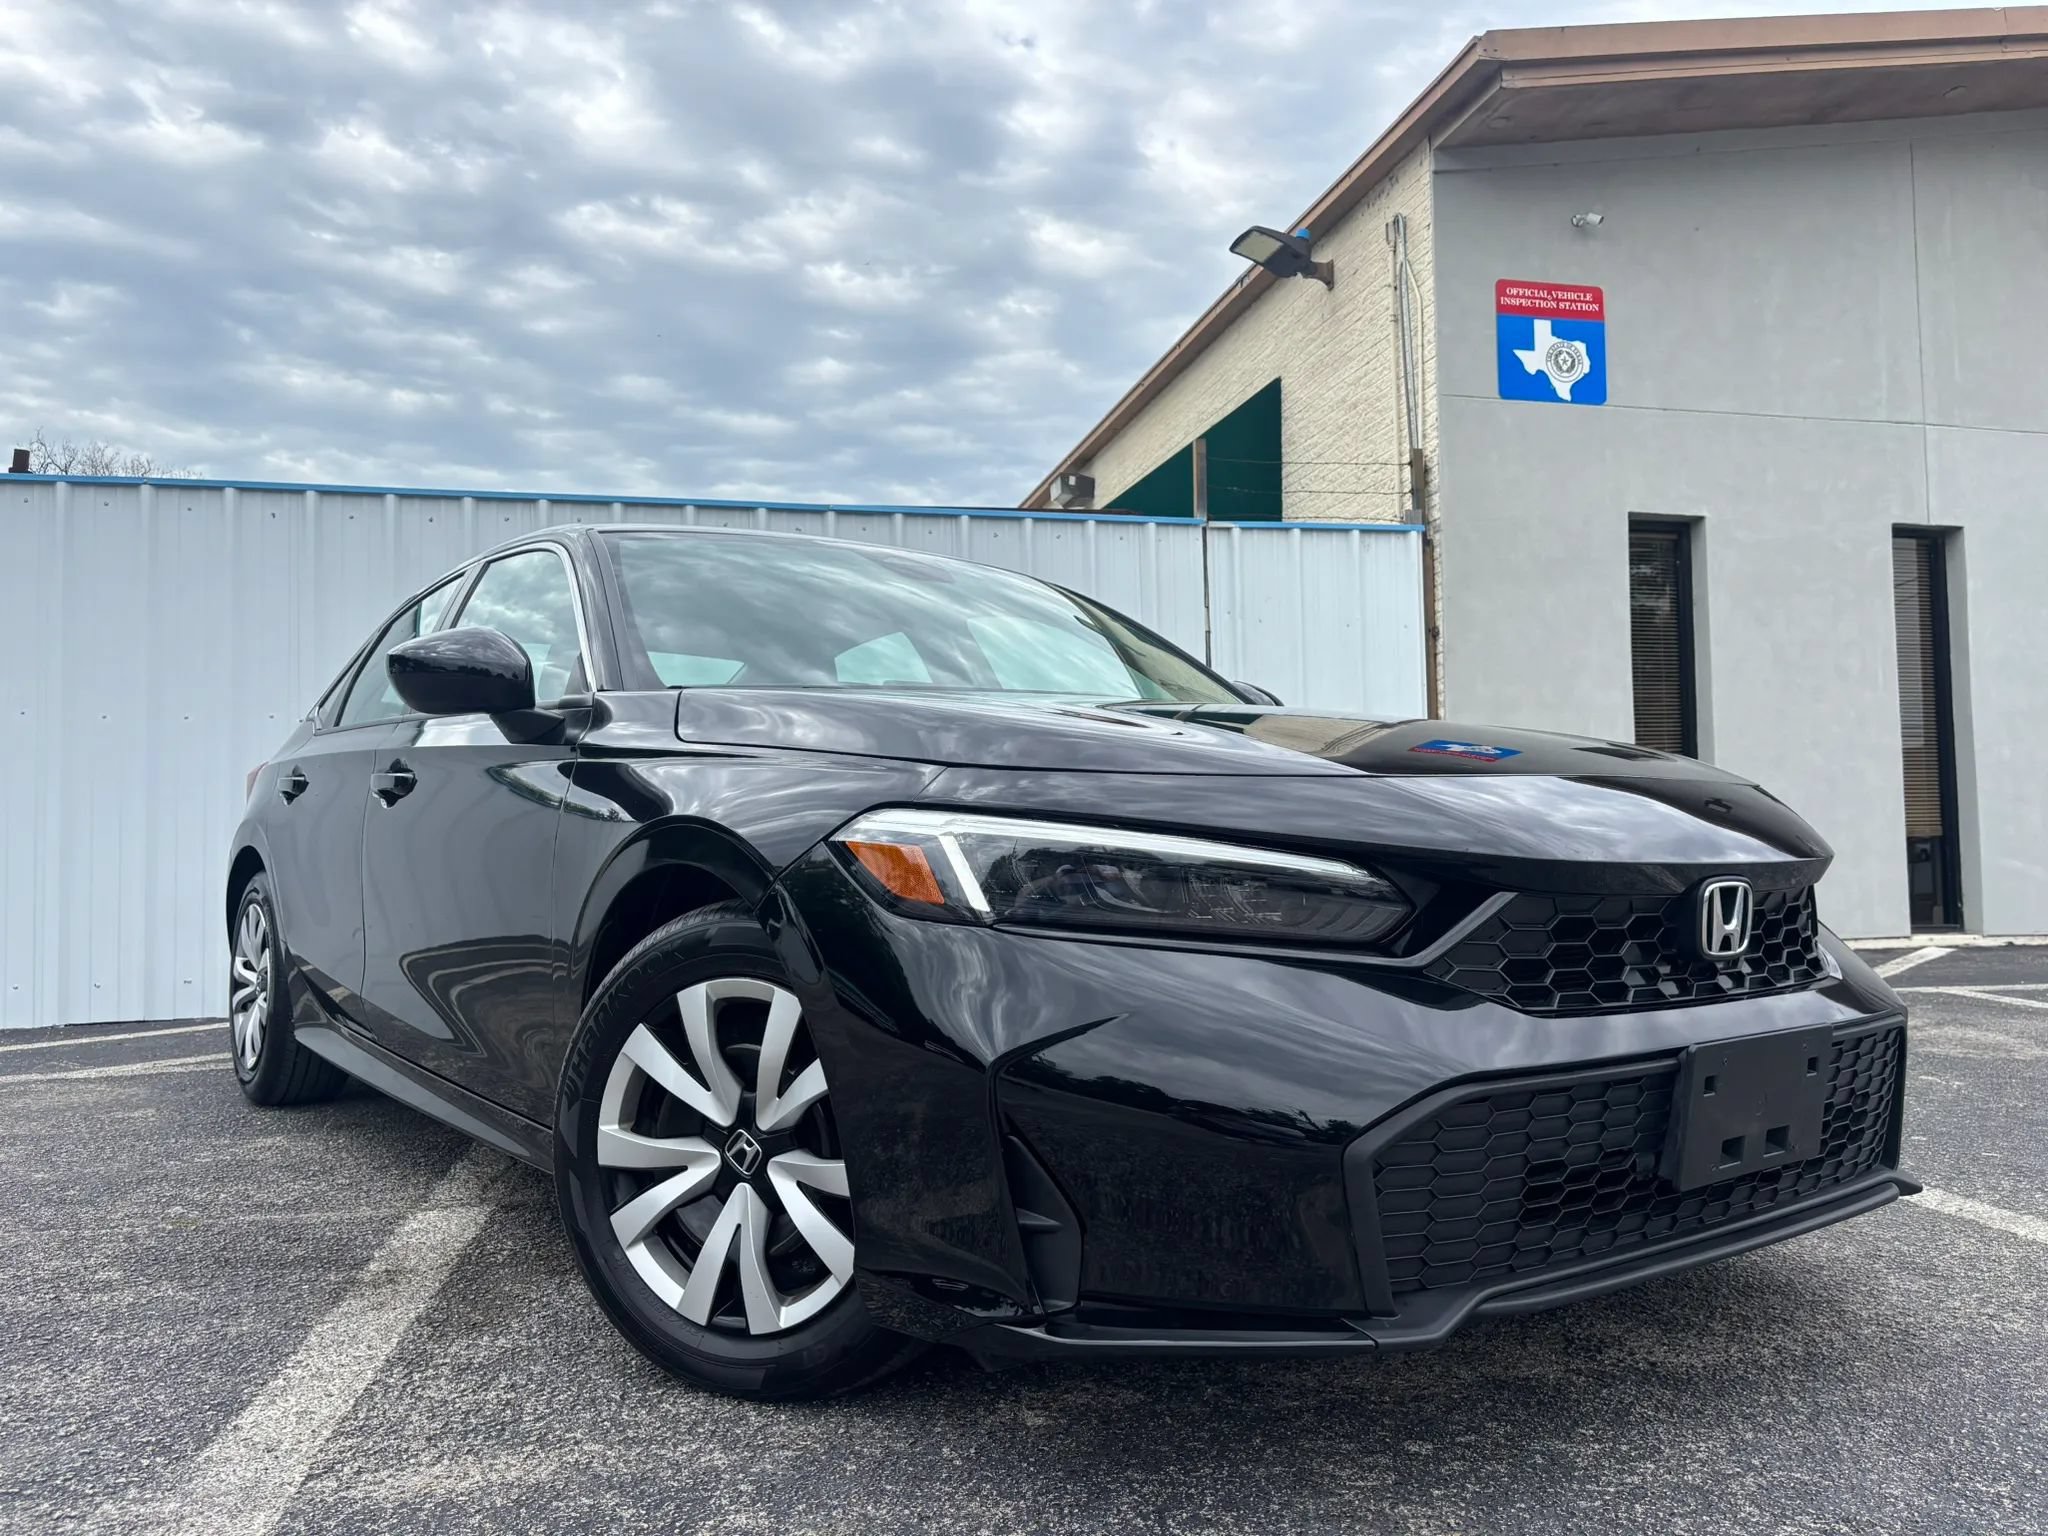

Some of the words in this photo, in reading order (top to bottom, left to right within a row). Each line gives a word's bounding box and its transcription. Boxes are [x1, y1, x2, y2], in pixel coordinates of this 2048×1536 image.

[1506, 287, 1548, 299] OFFICIAL
[1552, 290, 1593, 301] VEHICLE
[1500, 296, 1557, 309] INSPECTION
[1559, 302, 1599, 312] STATION
